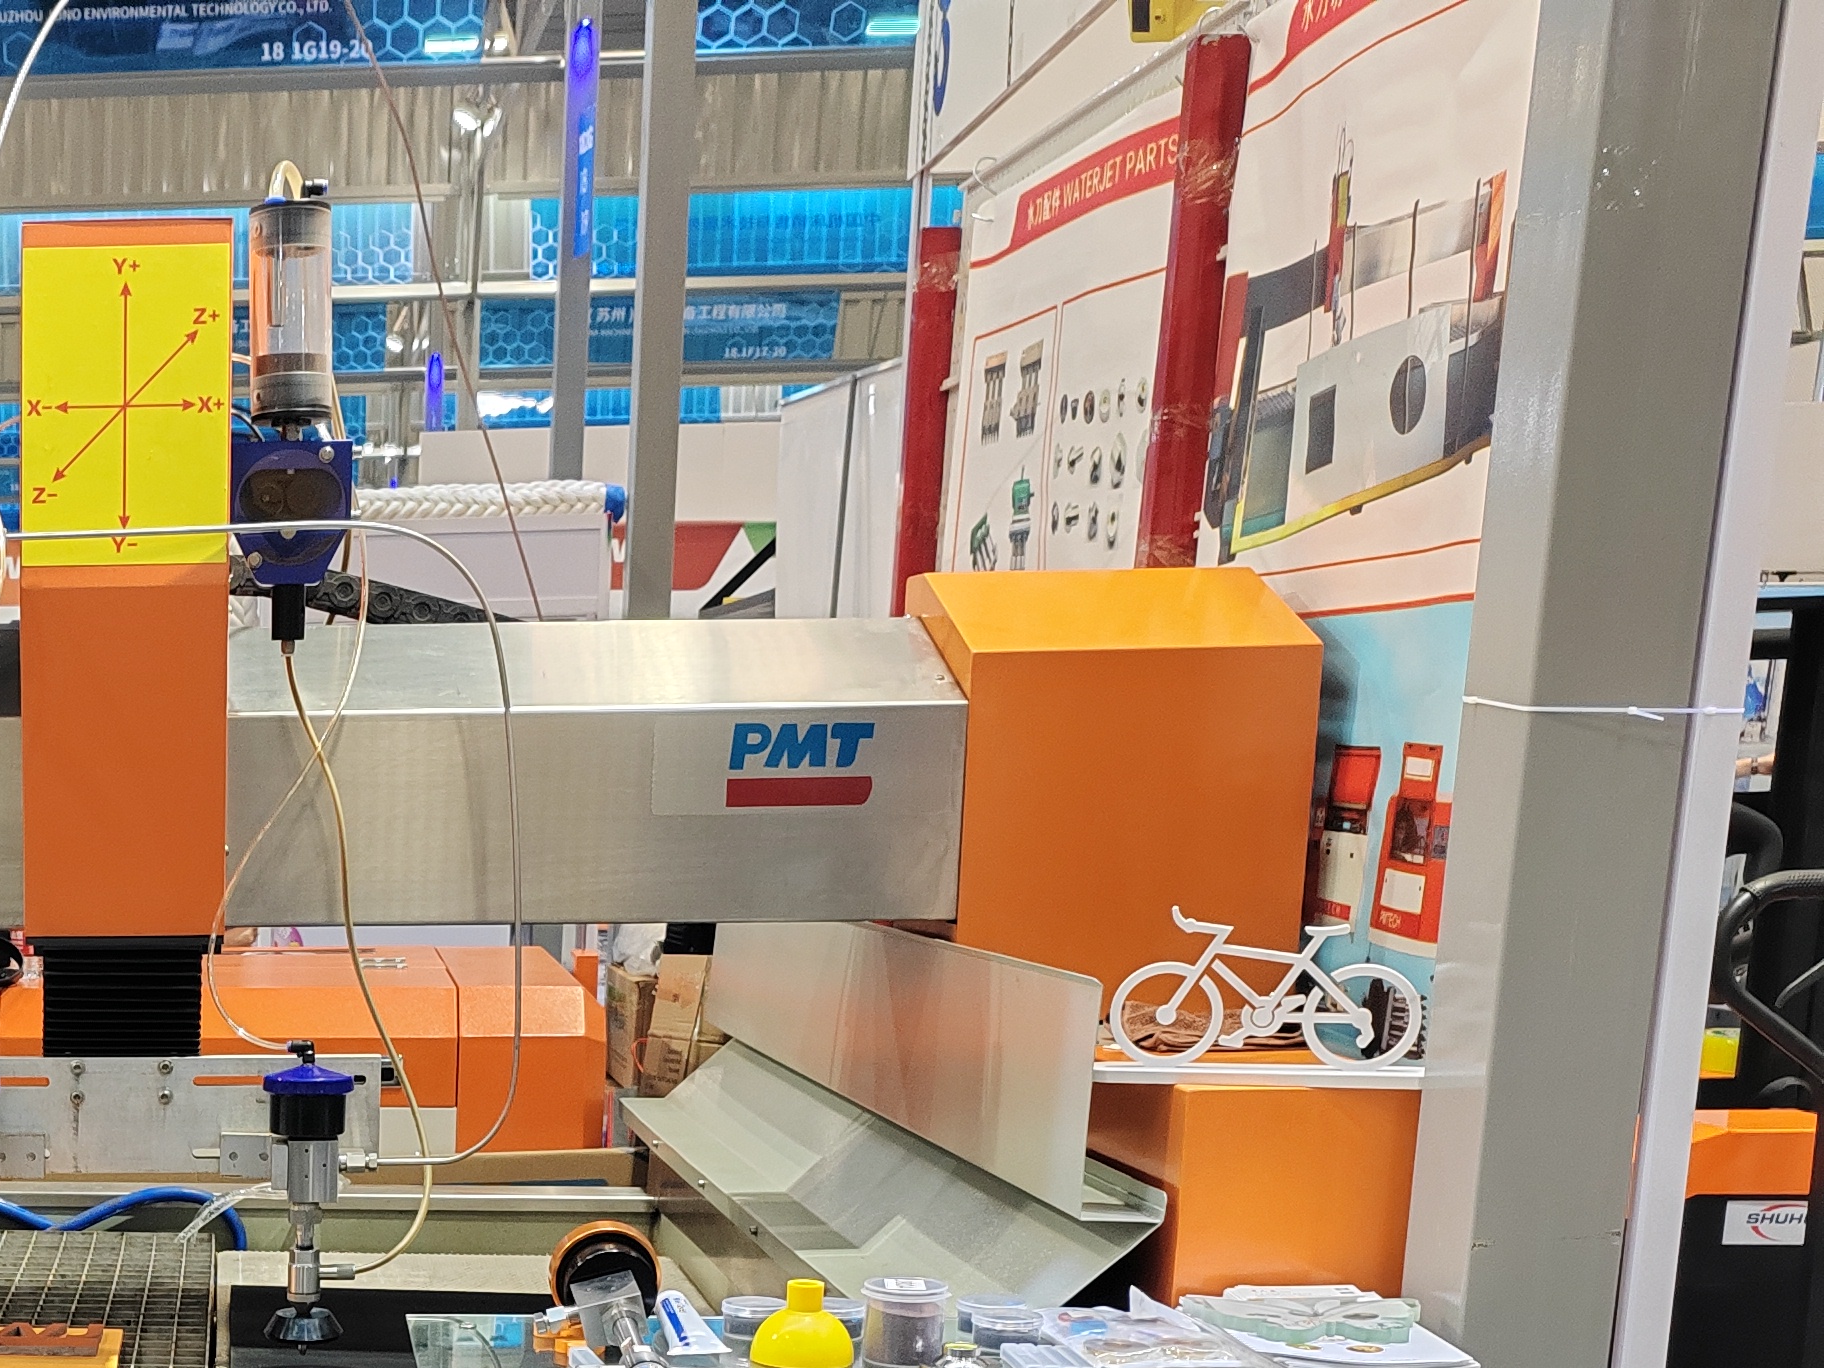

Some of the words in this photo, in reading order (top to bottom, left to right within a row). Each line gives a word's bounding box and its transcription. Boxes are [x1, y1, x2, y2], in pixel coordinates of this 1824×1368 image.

[84, 4, 189, 20] ENVIRONMENTAL
[192, 0, 275, 16] TECHNOLOGY
[1063, 156, 1123, 210] WATERJET
[1125, 133, 1179, 178] PARTS
[728, 722, 876, 771] PMT
[1746, 1212, 1808, 1226] SHUH
